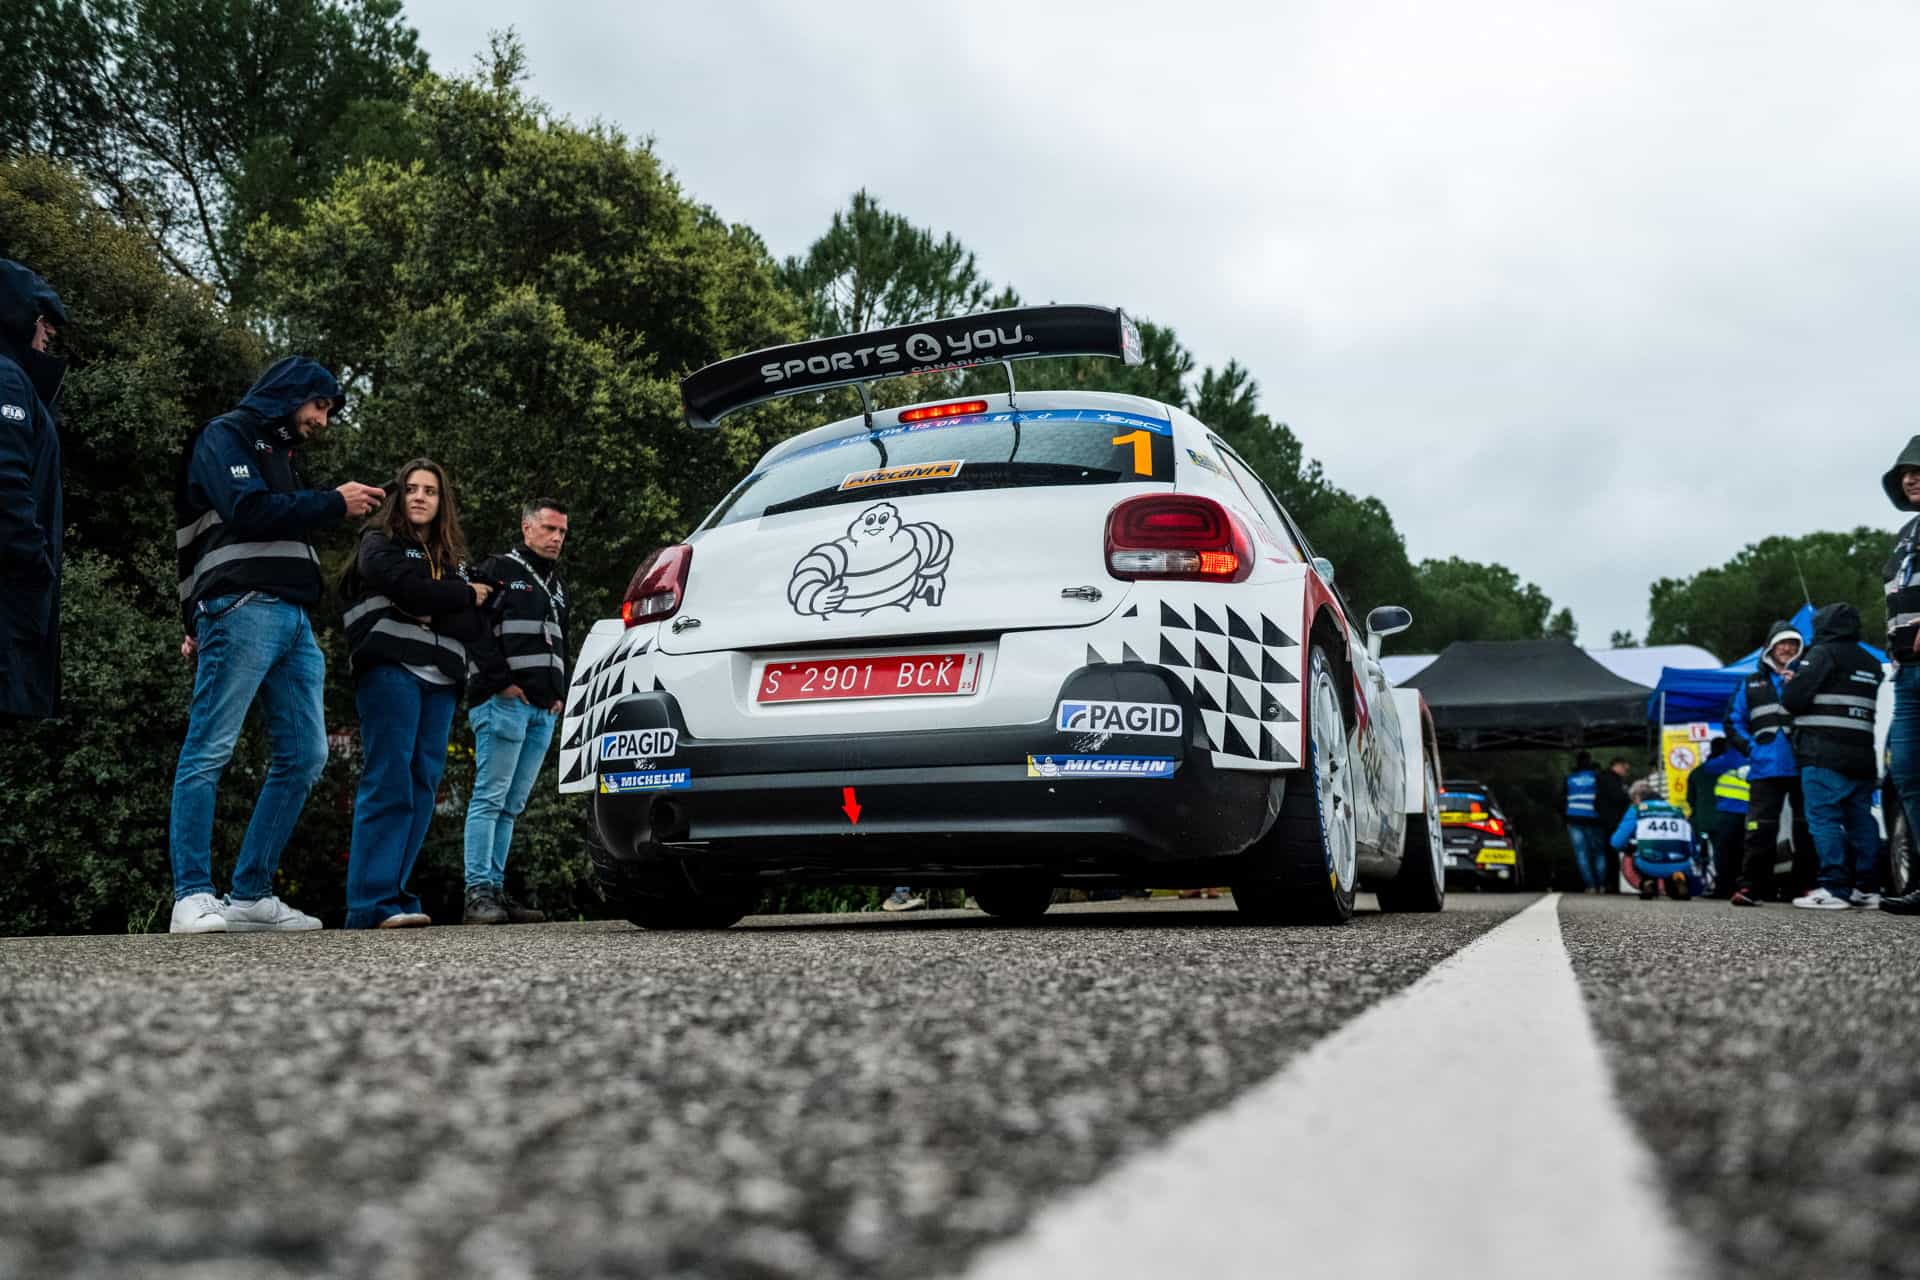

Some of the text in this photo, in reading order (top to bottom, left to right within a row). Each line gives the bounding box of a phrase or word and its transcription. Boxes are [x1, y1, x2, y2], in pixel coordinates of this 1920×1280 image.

[760, 344, 900, 384] SPORTS
[1, 404, 25, 420] FIA
[1112, 430, 1152, 476] 1
[765, 660, 954, 695] S 2901 BCK
[1090, 705, 1180, 732] PAGID
[618, 731, 674, 757] PAGID
[1064, 759, 1166, 772] MICHELIN
[621, 772, 685, 787] MICHELIN
[1648, 821, 1679, 832] 440
